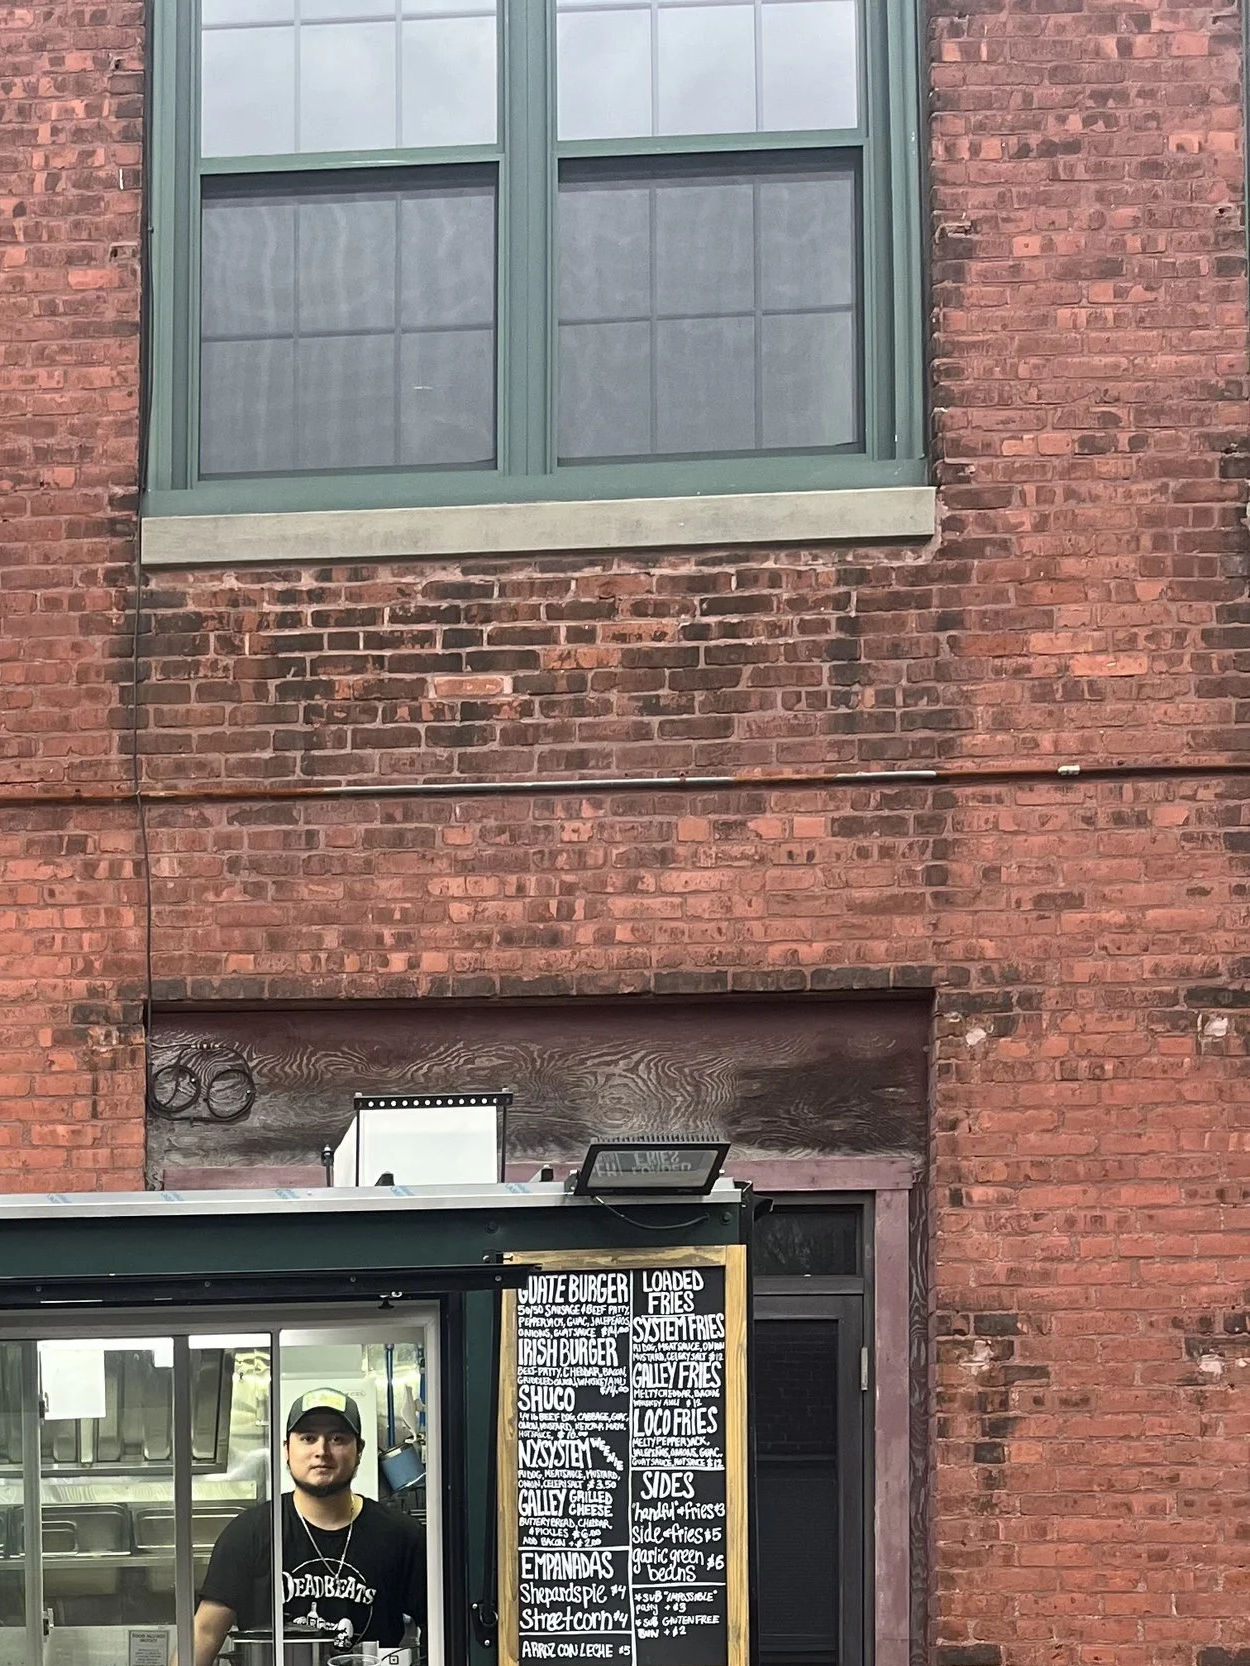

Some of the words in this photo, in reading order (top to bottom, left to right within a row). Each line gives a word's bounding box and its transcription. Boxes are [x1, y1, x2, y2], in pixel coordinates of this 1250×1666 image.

[569, 1273, 629, 1303] BURGER
[643, 1270, 704, 1292] LOADED
[545, 1304, 580, 1317] SAUSAGE
[586, 1305, 607, 1315] BEEF
[648, 1291, 694, 1314] FRIES
[633, 1316, 687, 1343] SYSTEM
[688, 1313, 725, 1341] FRIES
[518, 1338, 558, 1366] IRISH
[559, 1337, 619, 1367] BURGER
[633, 1361, 677, 1388] GALLEY
[678, 1361, 721, 1389] FRIES
[634, 1408, 671, 1437] LOCO
[673, 1406, 718, 1435] FRIES
[587, 1480, 617, 1490] $3.50
[641, 1471, 695, 1500] SIDES
[518, 1489, 567, 1517] GALLEY
[569, 1489, 614, 1505] GRILLED
[569, 1503, 614, 1517] CHEESE
[714, 1502, 725, 1517] $3
[535, 1527, 569, 1538] PICKLES
[704, 1527, 722, 1543] $5
[541, 1537, 566, 1547] BACON
[521, 1551, 614, 1580] EMPANADAS
[633, 1546, 668, 1574] garlic
[670, 1549, 704, 1570] green
[707, 1553, 724, 1571] $6
[647, 1564, 696, 1582] beans
[282, 1571, 377, 1605] DEADBEATS
[610, 1584, 626, 1600] $4
[672, 1602, 686, 1612] $3
[613, 1610, 629, 1628] $4
[695, 1615, 720, 1624] FREE
[637, 1628, 660, 1639] BUN
[672, 1626, 686, 1637] $2
[522, 1641, 556, 1659] ARROZ
[557, 1643, 578, 1659] CON
[579, 1643, 614, 1658] LECHE
[618, 1645, 630, 1656] $5
